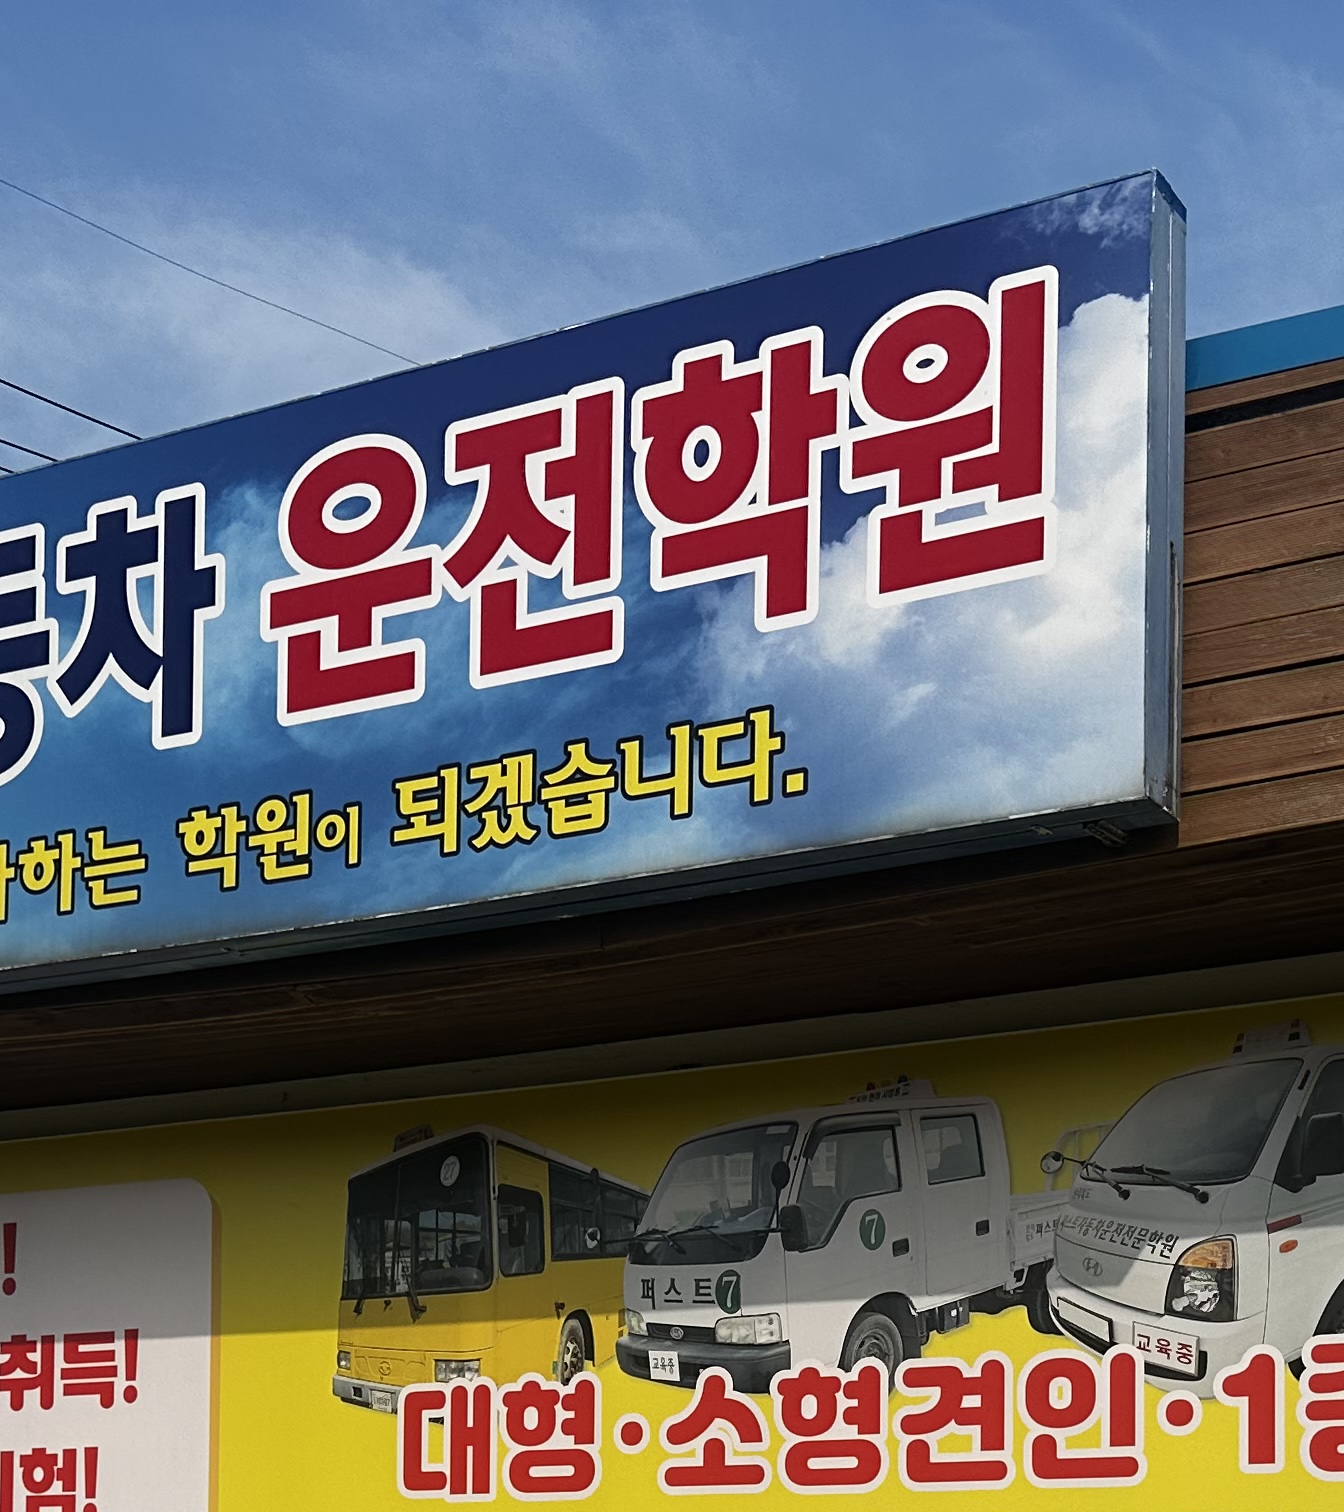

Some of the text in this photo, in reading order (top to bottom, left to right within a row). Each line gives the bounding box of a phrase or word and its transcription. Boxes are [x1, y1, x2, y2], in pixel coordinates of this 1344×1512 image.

[262, 264, 1058, 726] 운전학원
[177, 790, 362, 890] 학원이
[390, 705, 808, 857] 되겠습니다.
[865, 1214, 878, 1245] 7
[641, 1276, 737, 1310] 퍼스트 7
[1136, 1333, 1194, 1365] 교육중
[652, 1358, 675, 1375] 교육중
